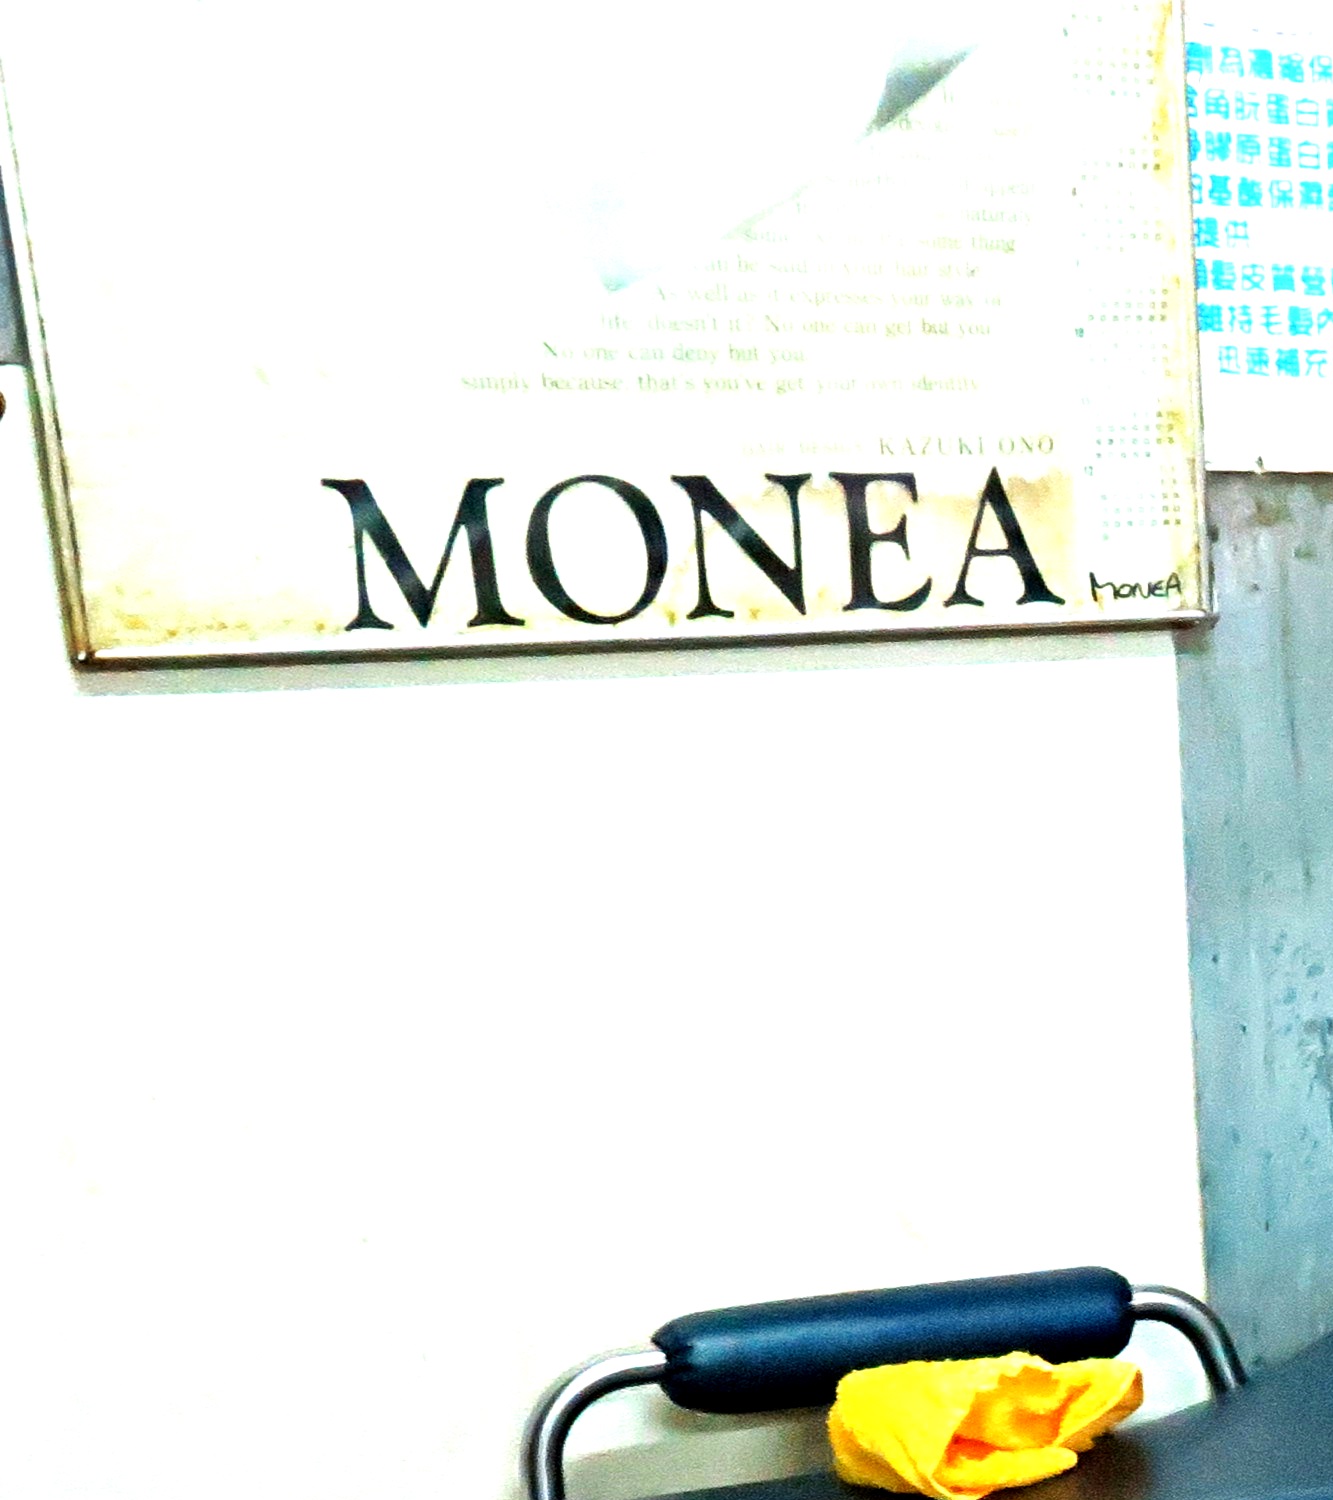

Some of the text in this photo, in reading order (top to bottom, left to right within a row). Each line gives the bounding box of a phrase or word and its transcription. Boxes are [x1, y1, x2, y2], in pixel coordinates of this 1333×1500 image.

[878, 433, 985, 457] KAZUKI
[996, 432, 1058, 457] ONO
[320, 466, 1067, 632] MONEA
